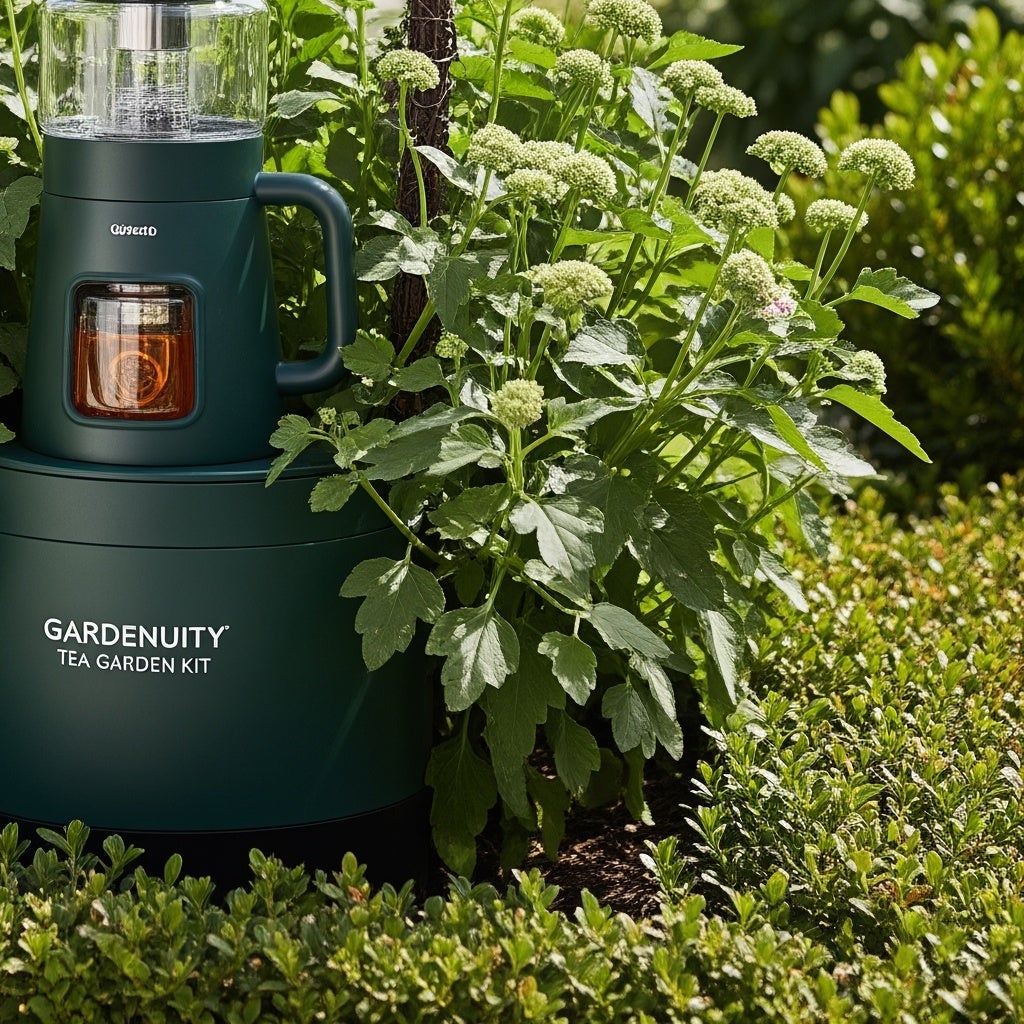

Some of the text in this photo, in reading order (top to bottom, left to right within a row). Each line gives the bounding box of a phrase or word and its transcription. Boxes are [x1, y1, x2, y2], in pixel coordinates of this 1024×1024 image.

[43, 617, 225, 649] GARDENUITY
[56, 649, 212, 674] TEA GARDEN KIT
